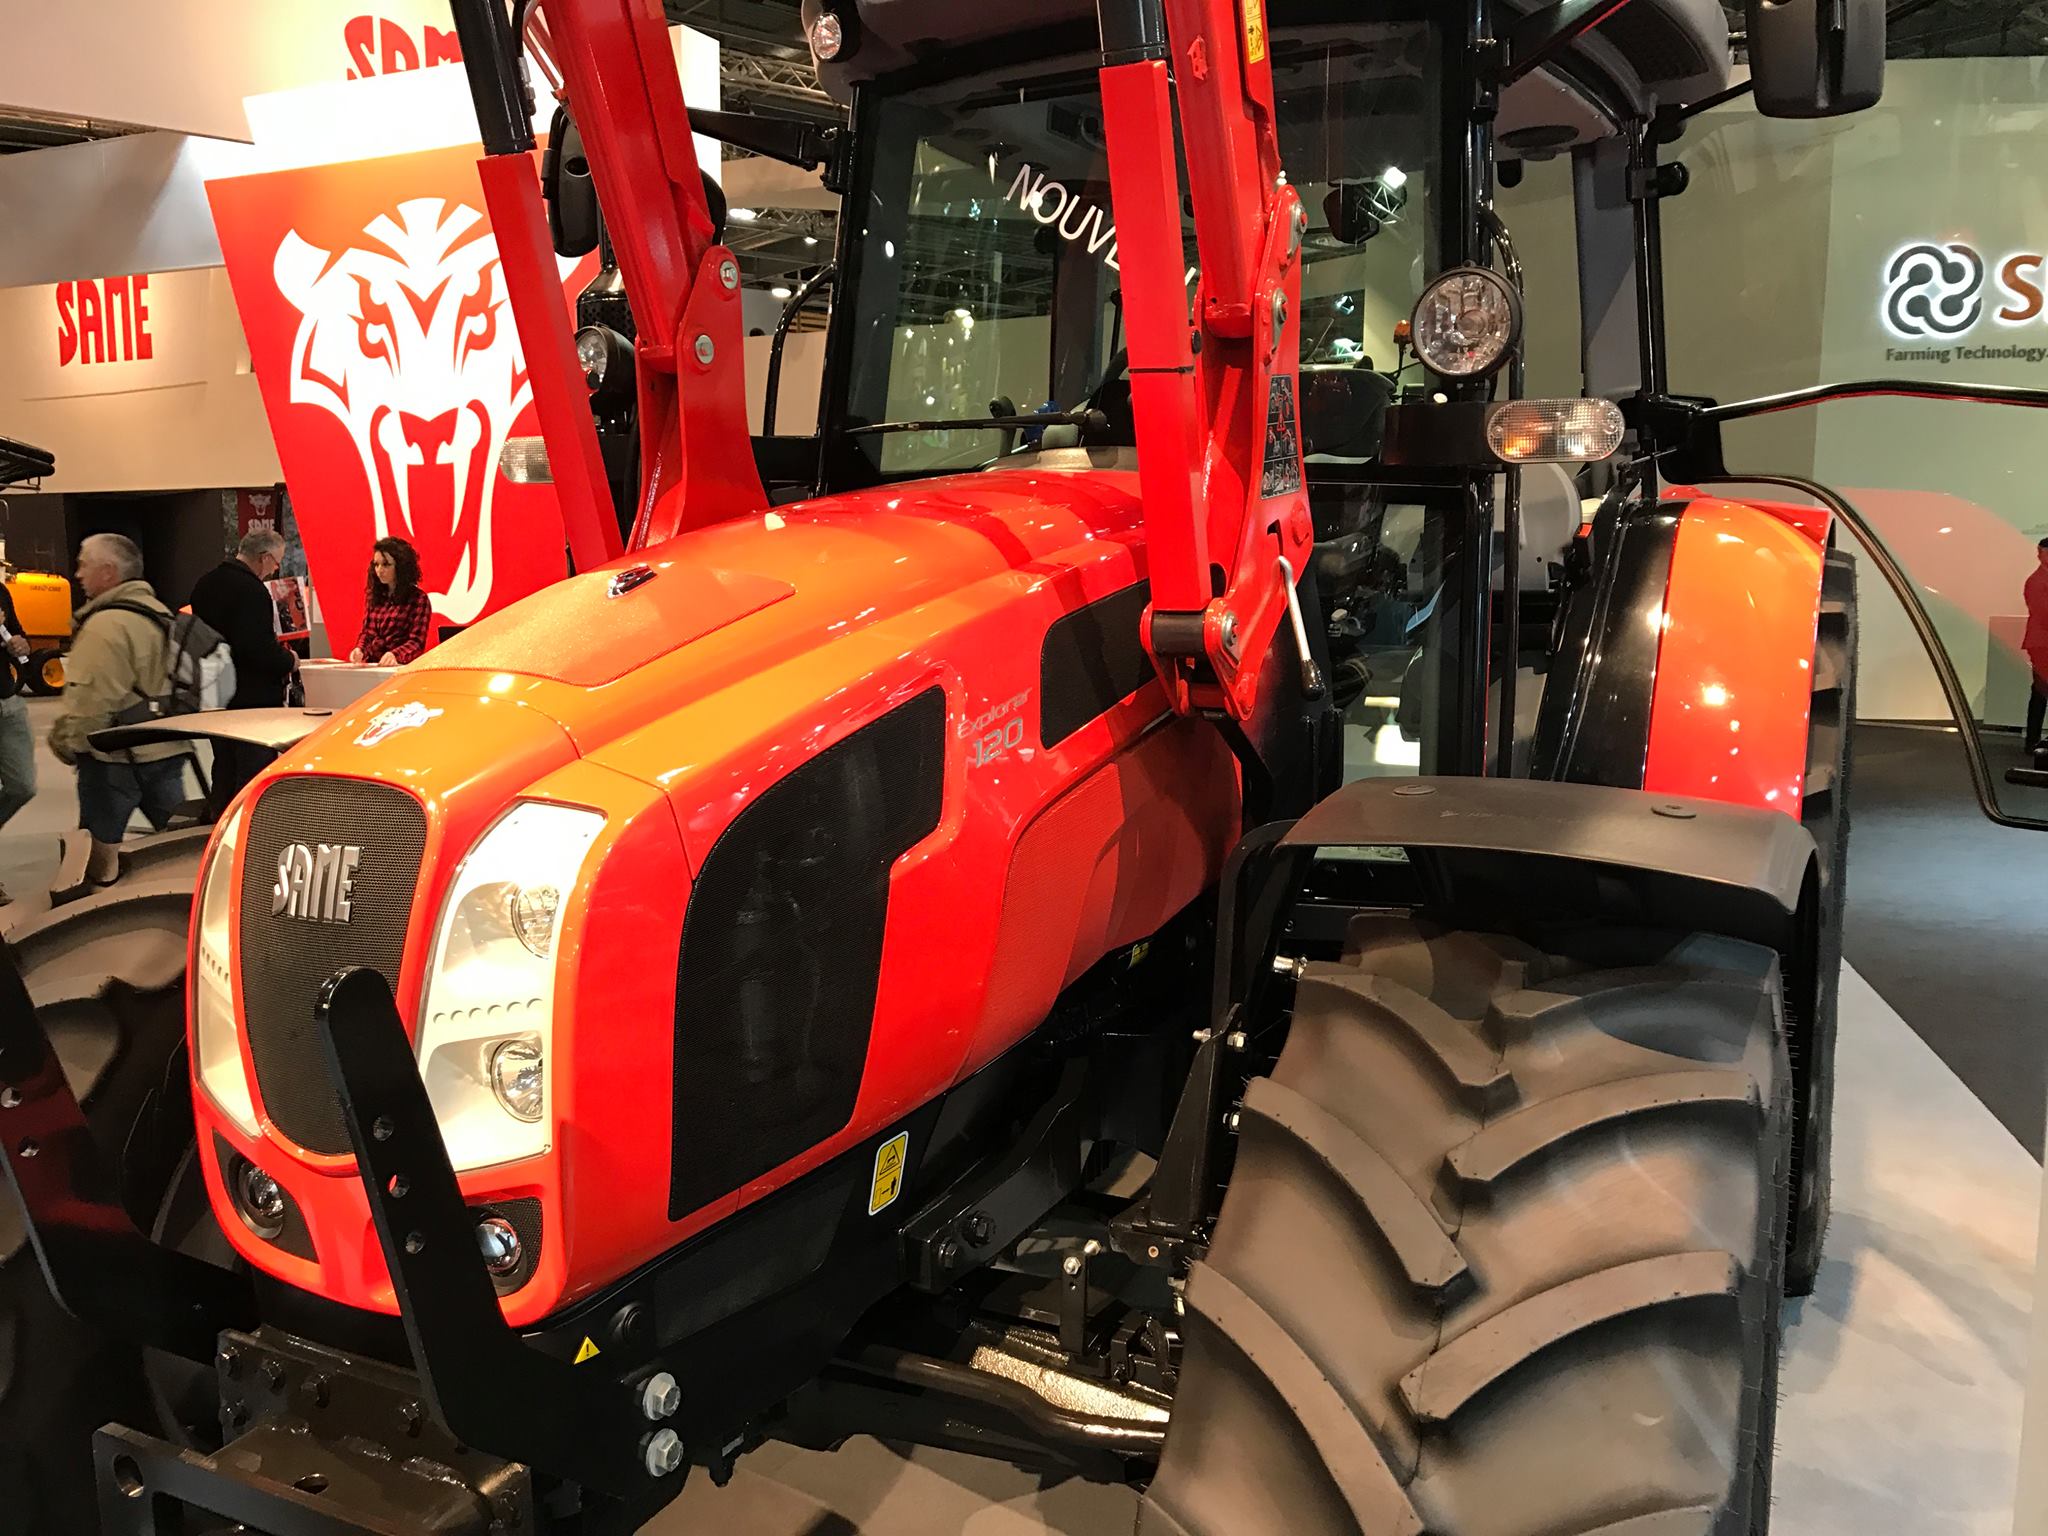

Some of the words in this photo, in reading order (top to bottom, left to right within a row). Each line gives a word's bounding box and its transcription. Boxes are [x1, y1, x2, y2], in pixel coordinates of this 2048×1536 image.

[55, 273, 153, 367] SAME
[1885, 346, 1950, 364] Farming
[975, 716, 1023, 769] 120
[271, 842, 361, 923] SAME
